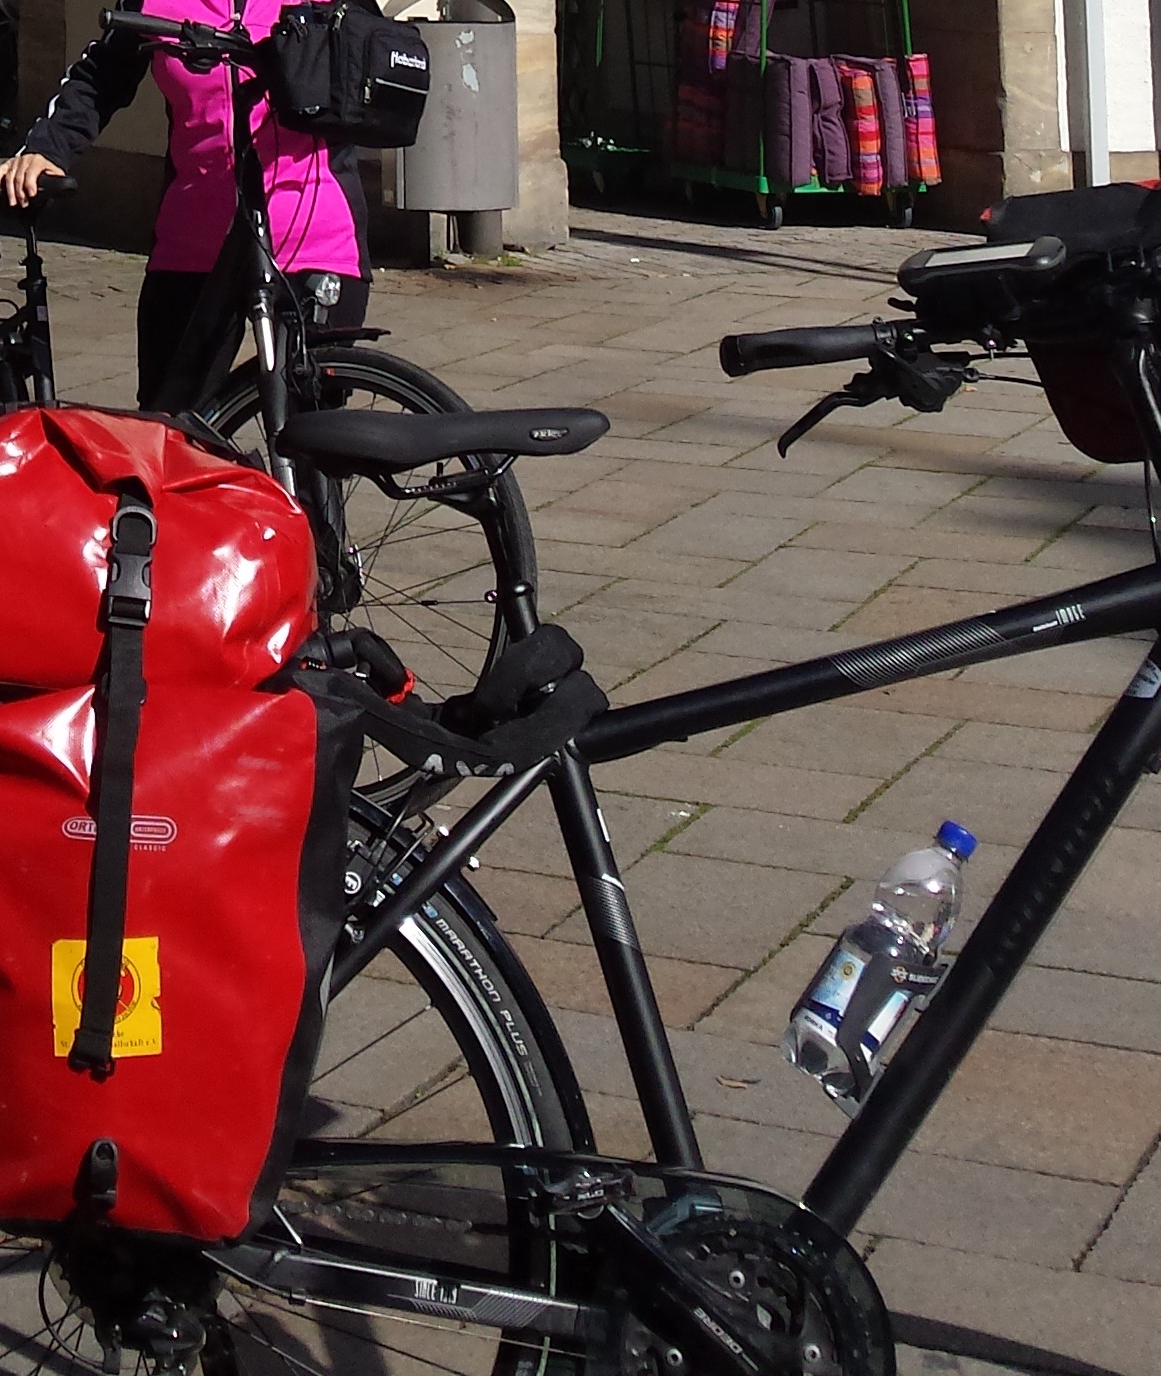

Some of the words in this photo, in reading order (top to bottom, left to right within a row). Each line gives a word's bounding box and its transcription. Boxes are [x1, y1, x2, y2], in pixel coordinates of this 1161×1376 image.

[435, 917, 502, 1003] MARATHON
[499, 1008, 529, 1057] PLUS
[693, 1307, 744, 1355] DEORE
